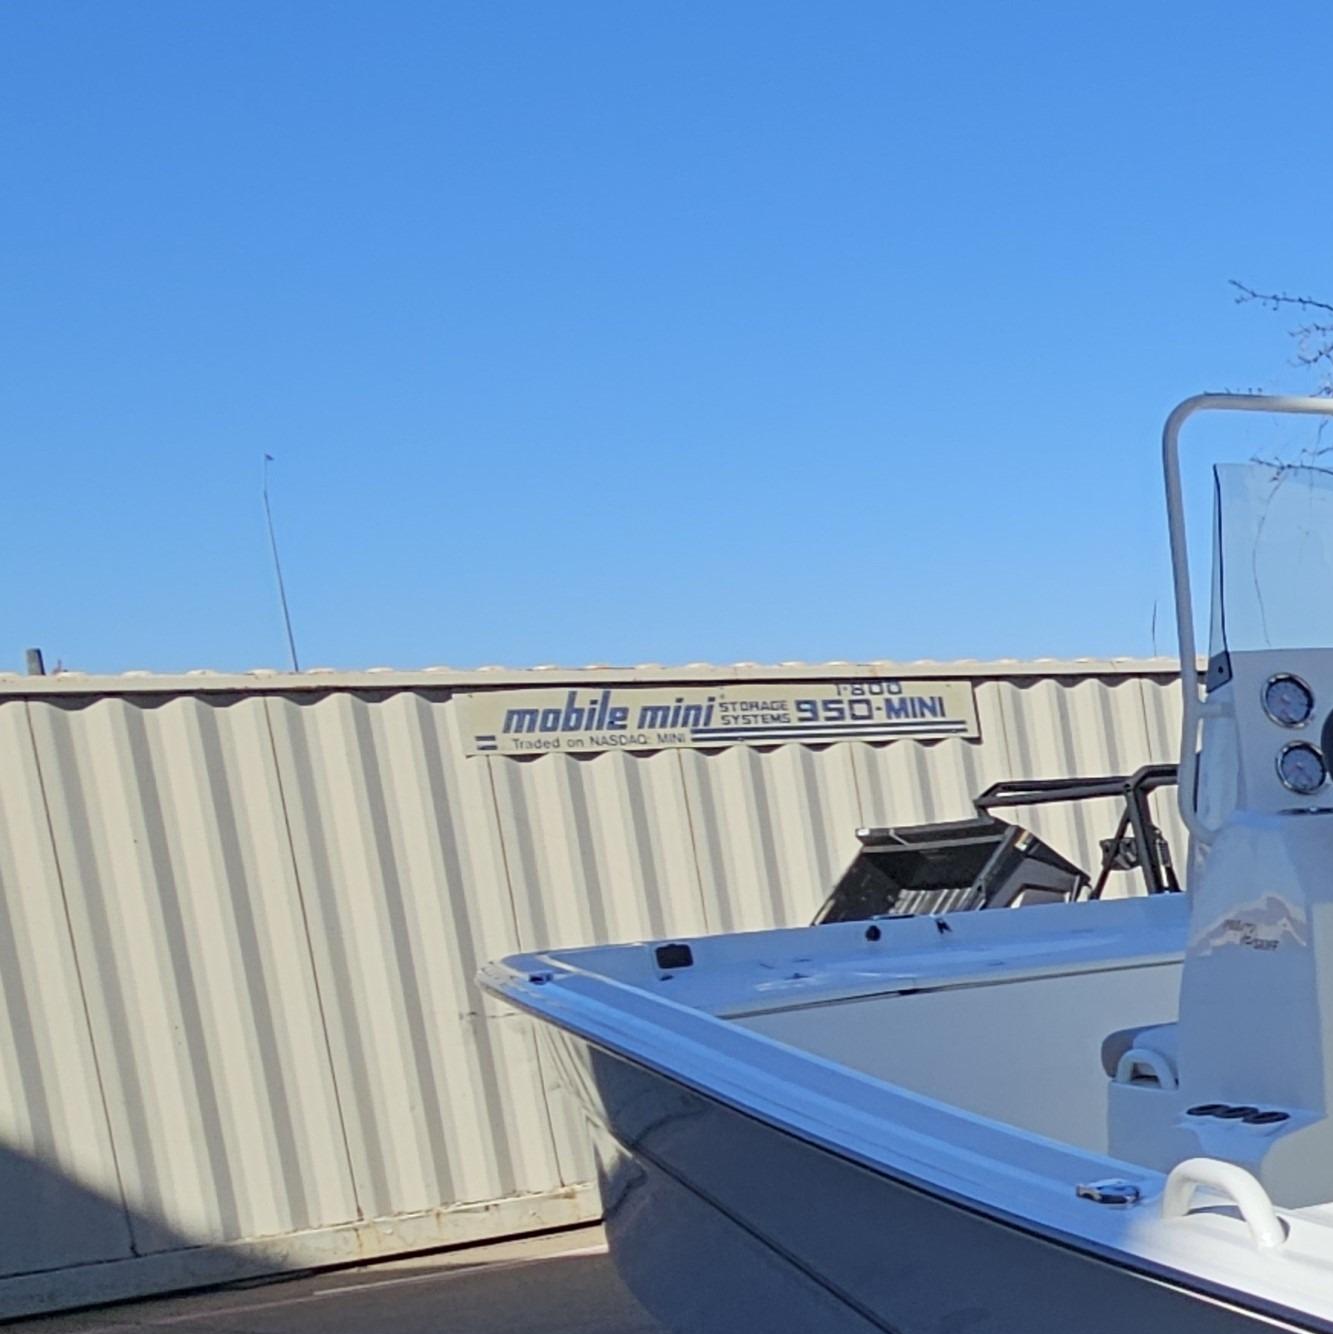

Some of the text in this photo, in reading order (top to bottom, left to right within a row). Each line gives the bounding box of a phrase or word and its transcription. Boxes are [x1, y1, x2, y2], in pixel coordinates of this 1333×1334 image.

[502, 690, 716, 734] mobile mini
[719, 700, 789, 713] STORAGE
[721, 713, 791, 725] SYSTEMS
[512, 737, 561, 750] Traded
[567, 739, 585, 748] on
[657, 732, 687, 744] MINI
